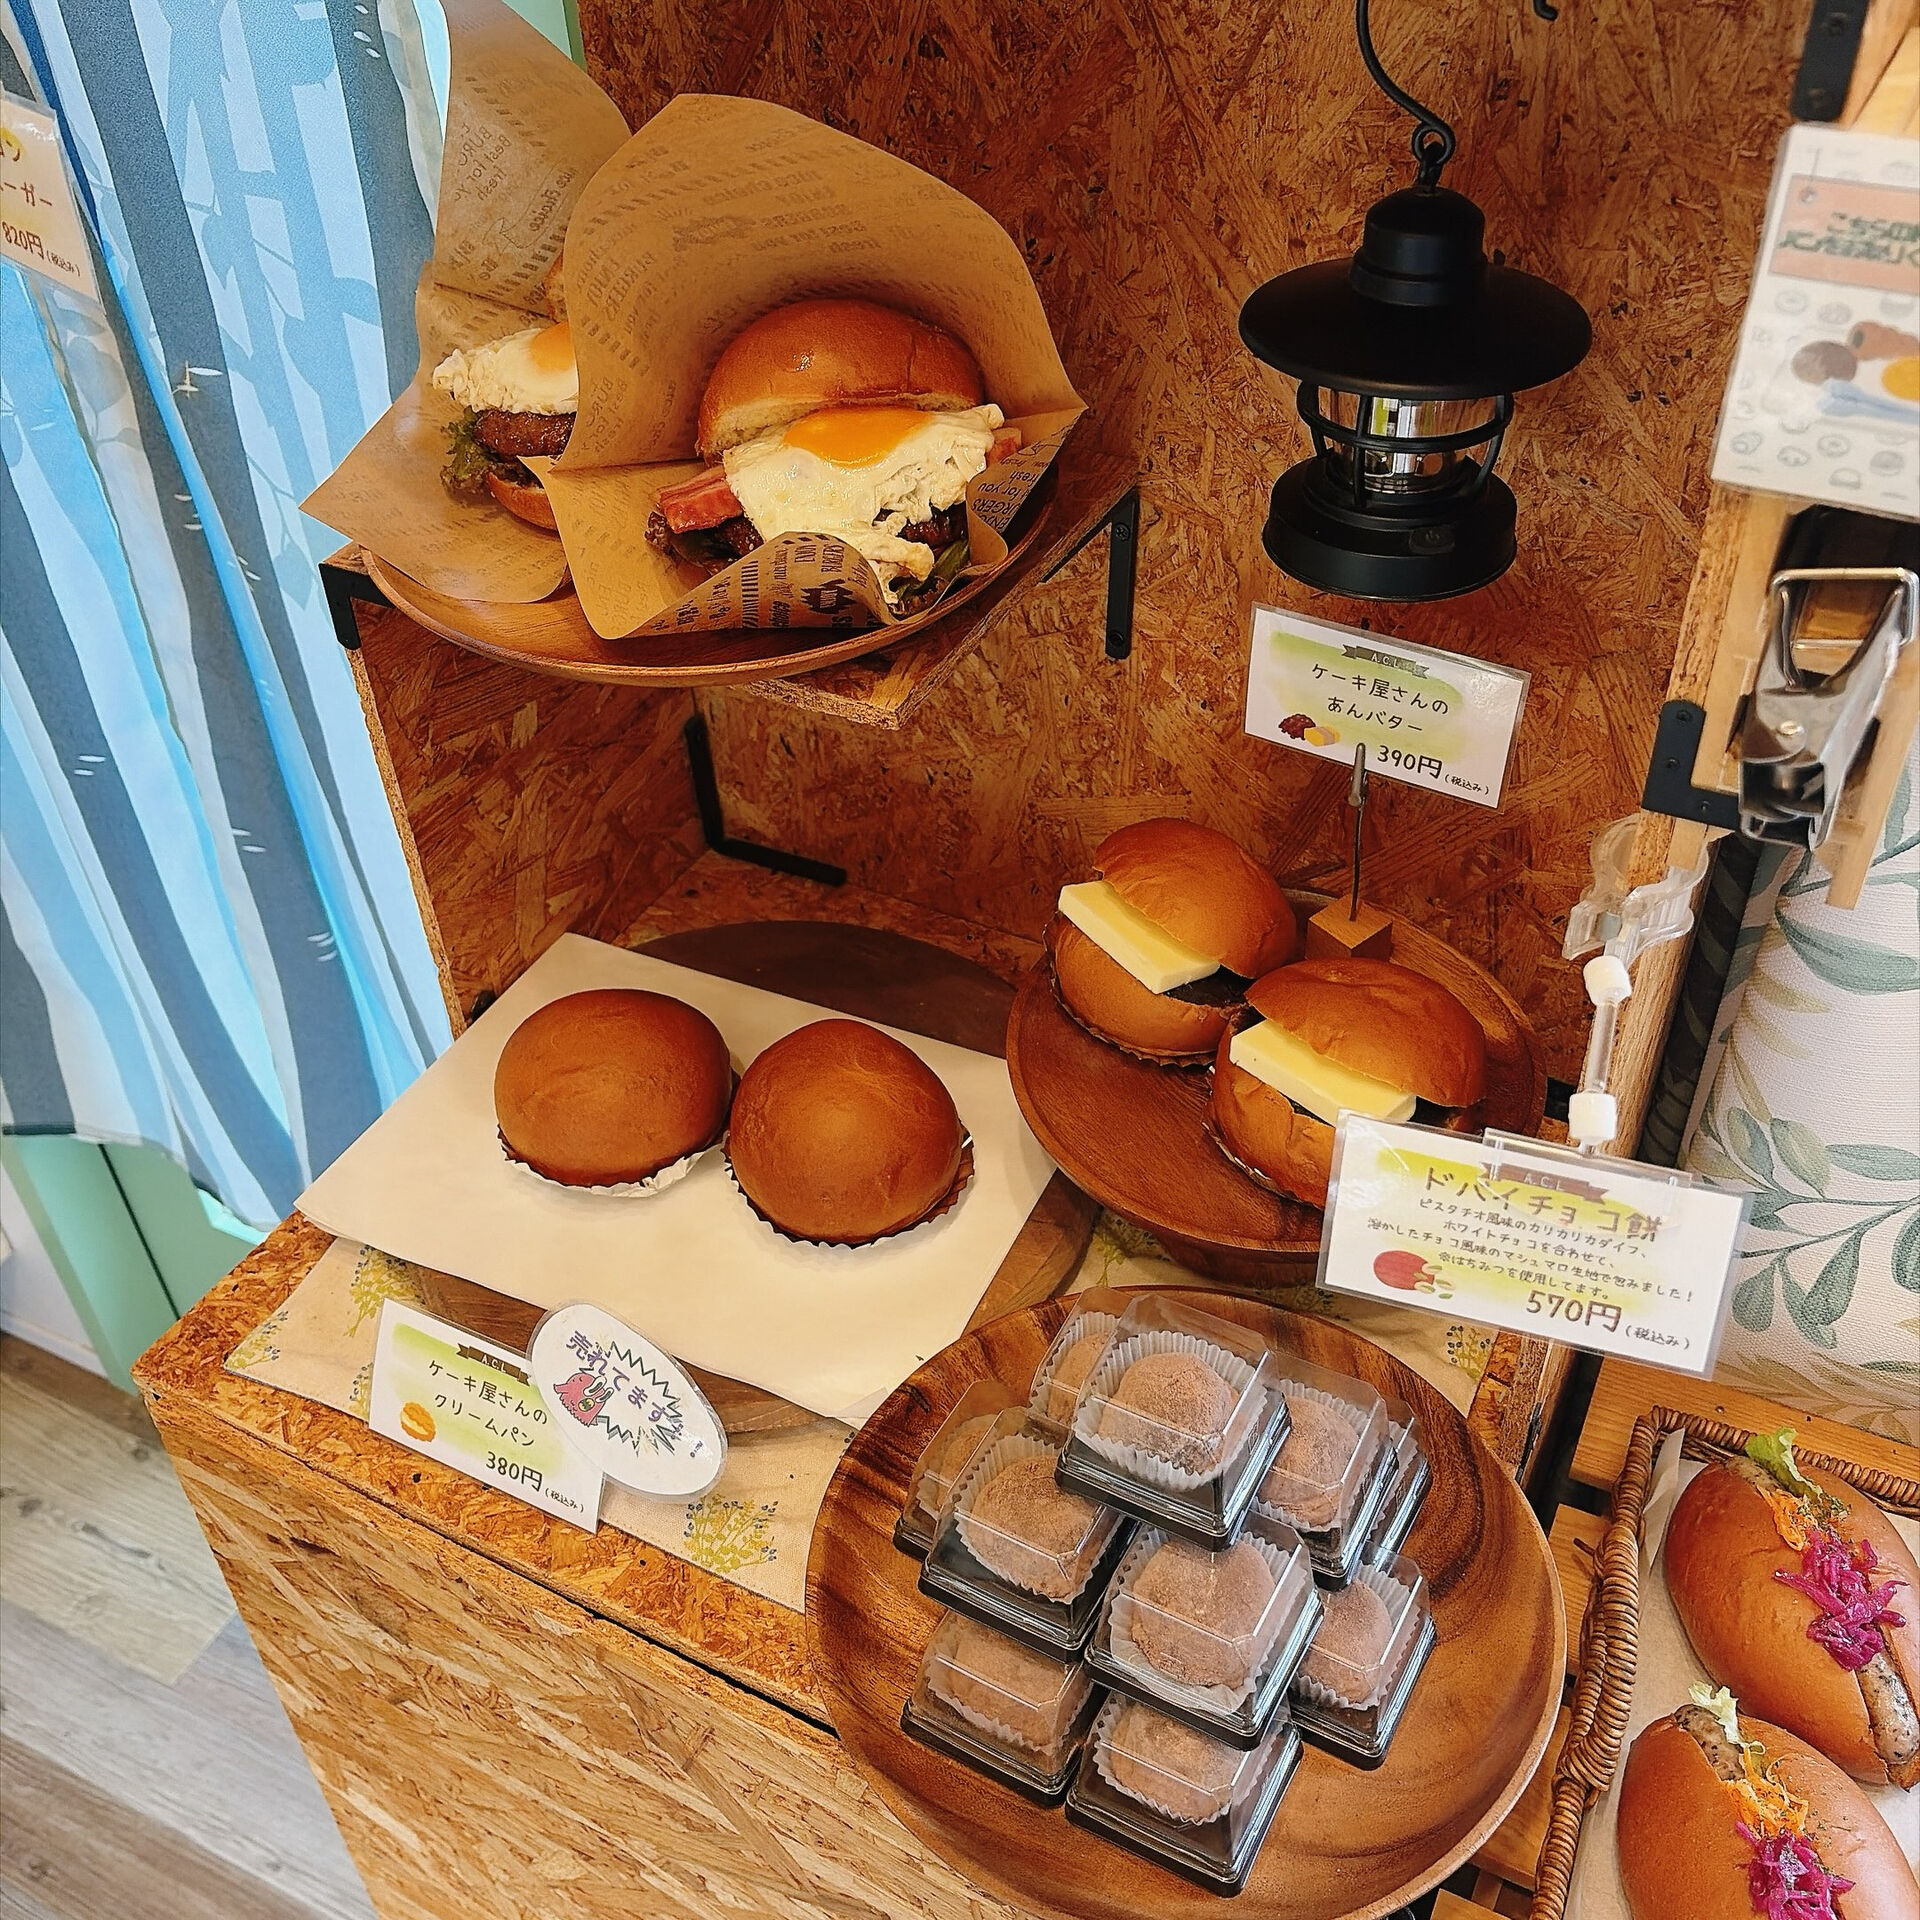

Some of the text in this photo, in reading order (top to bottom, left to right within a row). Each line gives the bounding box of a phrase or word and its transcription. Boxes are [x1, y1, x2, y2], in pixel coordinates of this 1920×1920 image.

[2, 221, 45, 260] 820円
[1311, 663, 1450, 715] ケーキ屋さんの
[1327, 695, 1423, 733] あんバター
[1376, 744, 1490, 796] 390円 (税込み)
[1442, 1219, 1615, 1269] ホワイトチョコを合わせて、
[1525, 1289, 1691, 1351] 570円 (税込み)
[428, 1358, 548, 1426] ケーキ屋さんの
[434, 1392, 536, 1449] クリームパン
[485, 1450, 585, 1514] 380円 (税込み)
